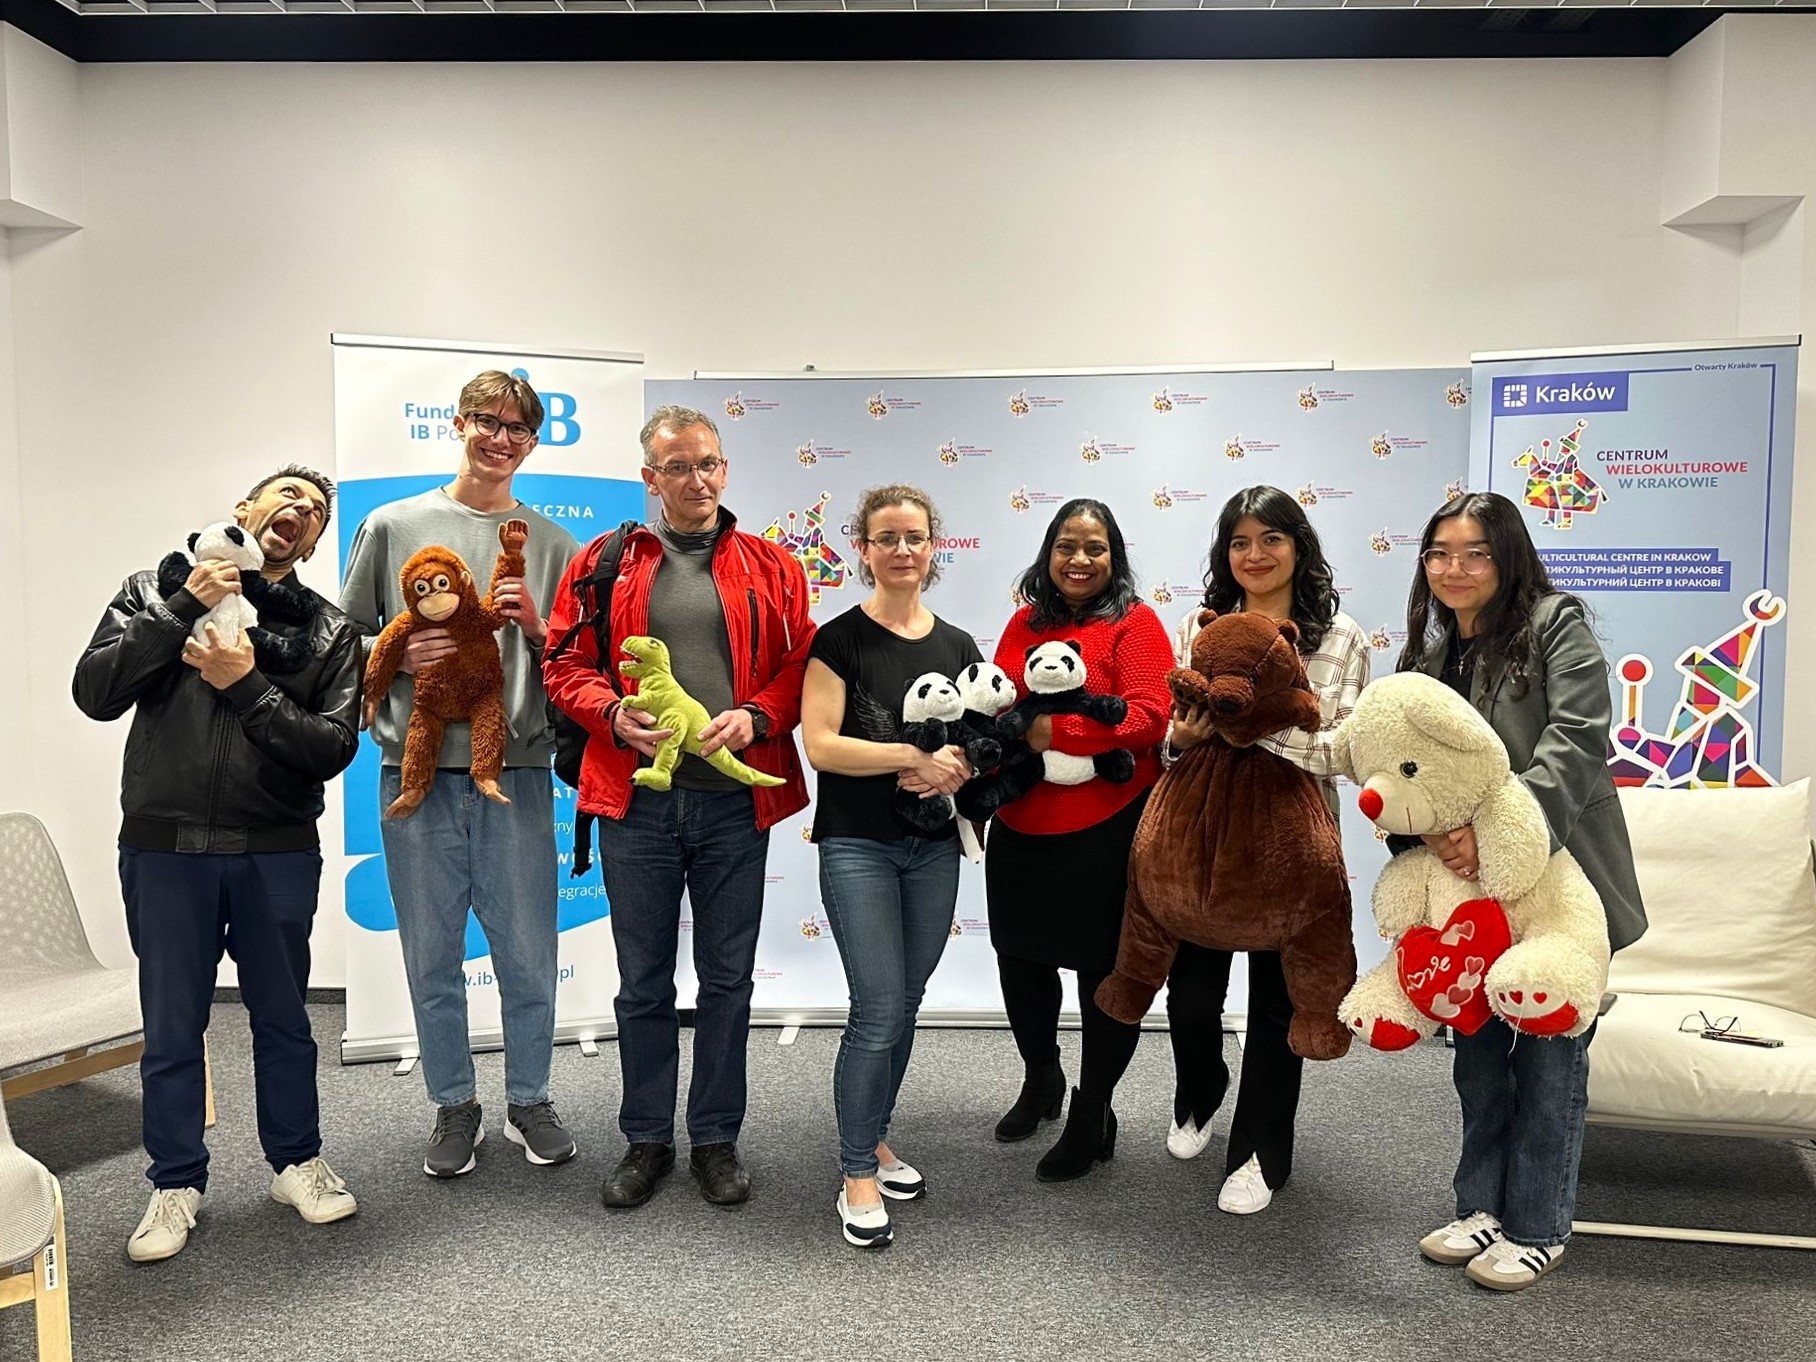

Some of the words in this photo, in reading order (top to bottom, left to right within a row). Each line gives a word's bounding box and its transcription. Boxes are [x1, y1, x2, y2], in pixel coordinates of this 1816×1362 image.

[1694, 363, 1727, 371] Otwarty
[1728, 362, 1757, 370] Kraków
[1535, 382, 1616, 403] Kraków
[405, 403, 455, 420] Fund
[411, 424, 430, 439] IB
[1596, 449, 1668, 462] CENTRUM
[1606, 461, 1748, 475] WIELOKULTUROWE
[1618, 478, 1633, 489] W
[1637, 476, 1719, 489] KRAKOWIE
[532, 504, 594, 518] ECZNA
[1538, 553, 1609, 562] ULTICULTURAL
[1610, 553, 1649, 562] CENTRE
[1651, 553, 1662, 562] IN
[1664, 553, 1711, 561] KRAKOW
[1545, 564, 1628, 574] ТИКУЛЬТУРНЫЙ
[1629, 566, 1664, 576] ЦЕНТР
[1665, 566, 1673, 575] В
[1674, 566, 1724, 575] КРАКОВЕ
[1629, 578, 1664, 588] ЦЕНТР
[1665, 578, 1673, 587] В
[558, 884, 606, 900] egracje
